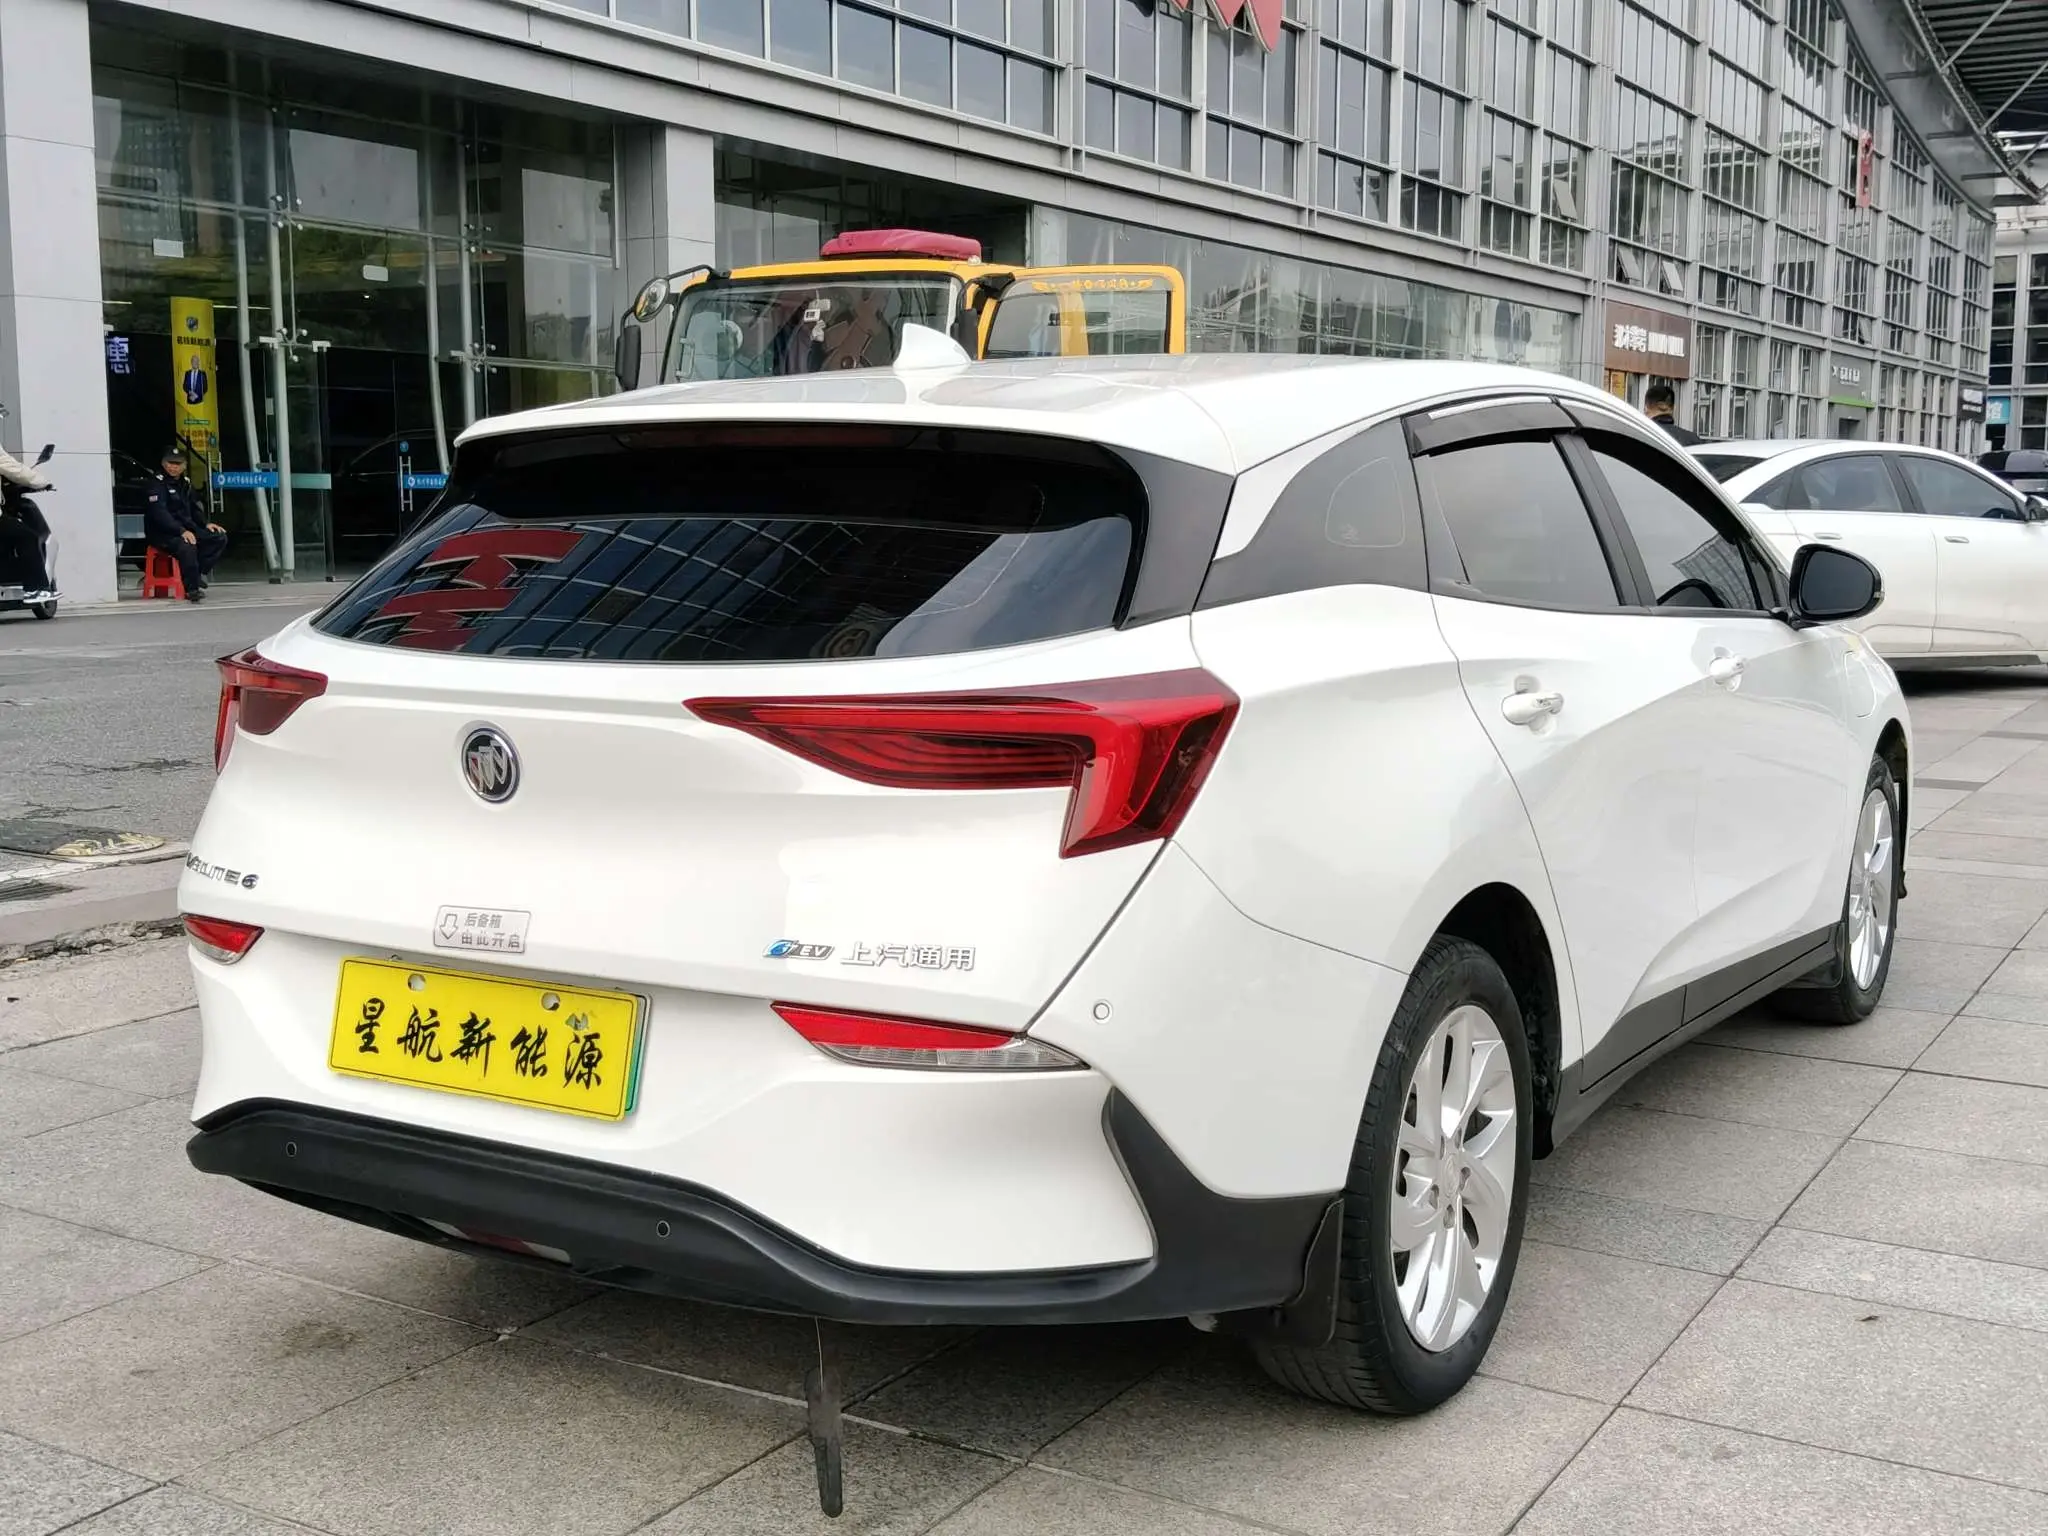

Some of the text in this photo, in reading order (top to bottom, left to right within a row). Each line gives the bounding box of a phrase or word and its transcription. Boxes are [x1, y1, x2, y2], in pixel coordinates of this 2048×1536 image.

[464, 912, 502, 929] 后备箱
[461, 929, 520, 949] 由此开启
[840, 940, 976, 972] 上汽通用
[354, 997, 603, 1090] 星航新能源
